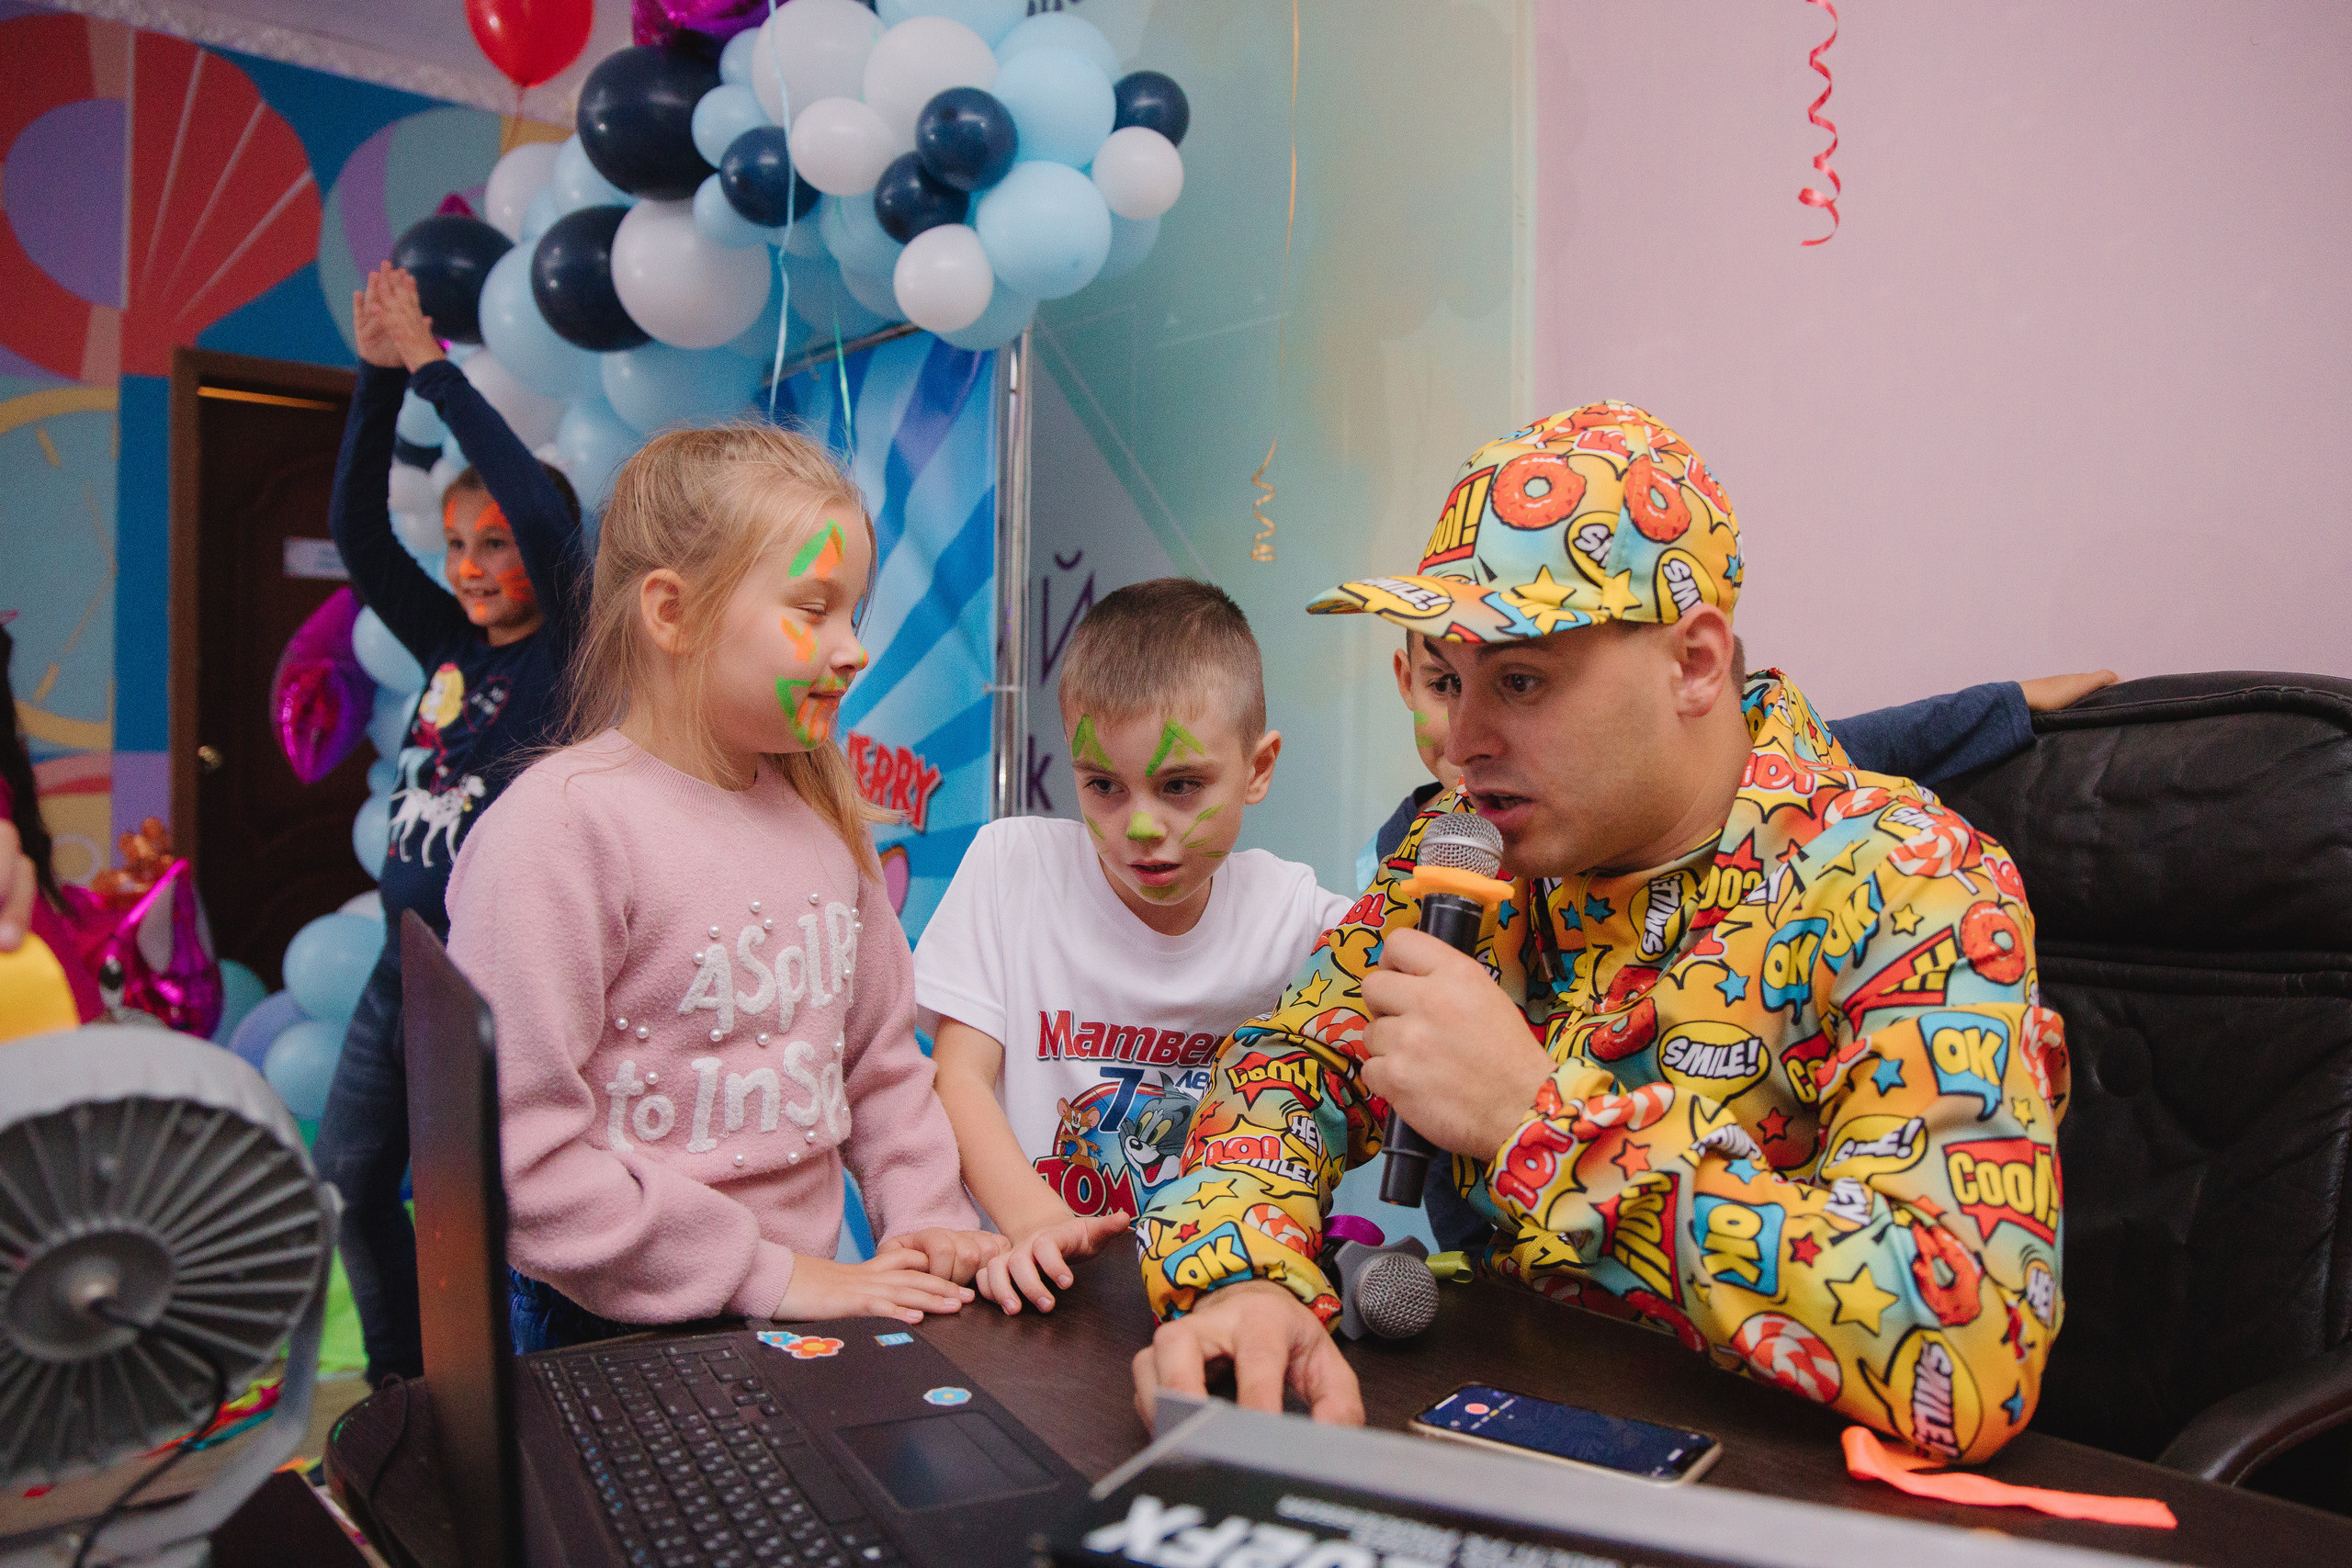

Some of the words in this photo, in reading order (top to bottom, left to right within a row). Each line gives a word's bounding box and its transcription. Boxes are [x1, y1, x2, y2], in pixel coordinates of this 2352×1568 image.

[847, 730, 943, 832] ERRY
[1762, 933, 1822, 989] OK
[1663, 1037, 1763, 1078] SMILE!
[1931, 1027, 2004, 1088] OK
[605, 1059, 676, 1152] to
[1098, 1066, 1146, 1133] 7
[1174, 1235, 1250, 1291] OK
[1702, 1203, 1764, 1286] OK
